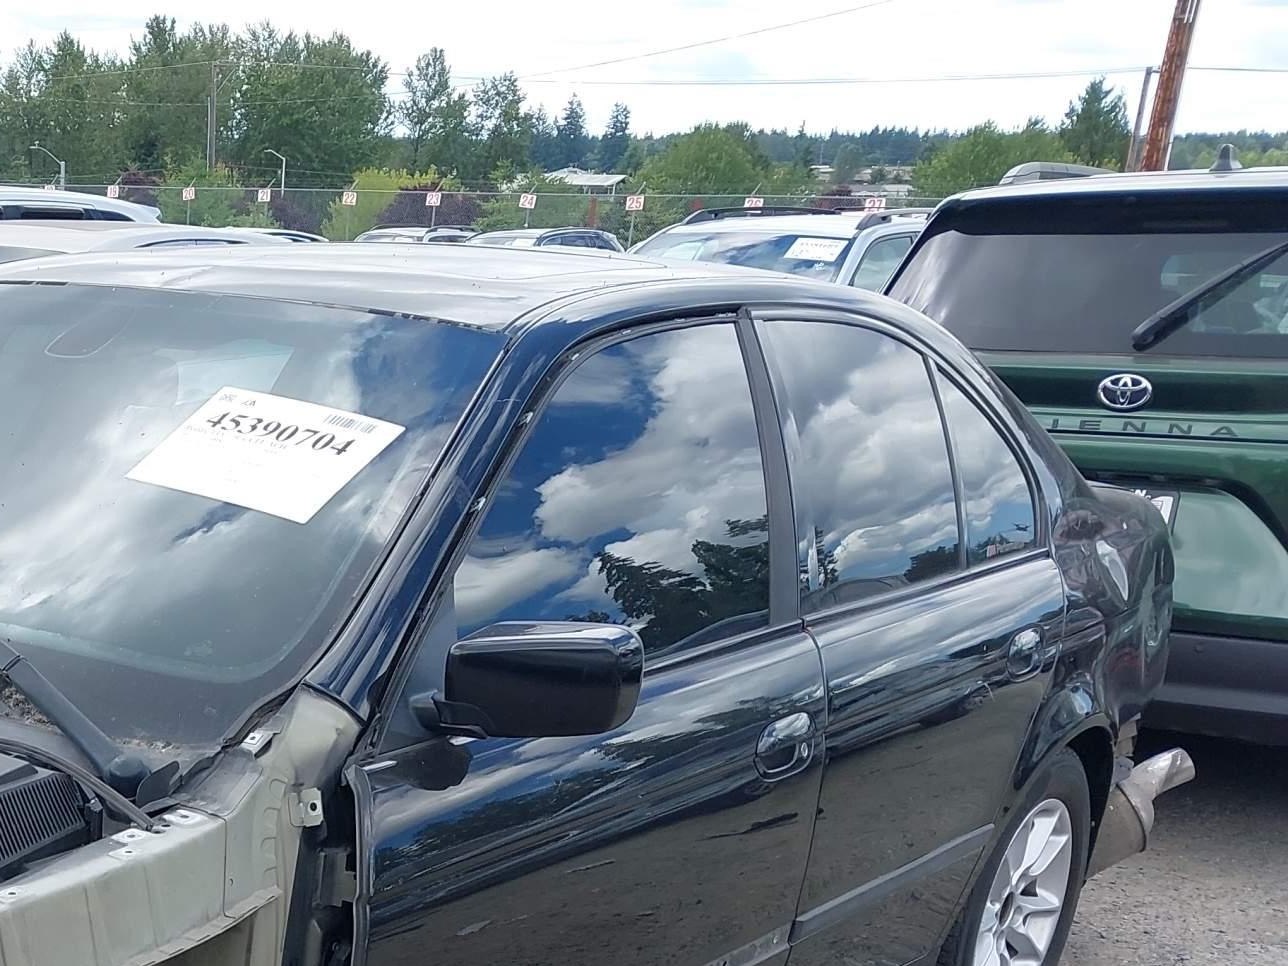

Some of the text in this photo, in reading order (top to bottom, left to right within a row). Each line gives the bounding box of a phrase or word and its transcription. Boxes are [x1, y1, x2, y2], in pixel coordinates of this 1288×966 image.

[108, 186, 118, 197] 19
[183, 188, 194, 199] 20
[259, 190, 269, 201] 21
[343, 192, 355, 204] 22
[427, 193, 440, 205] 23
[521, 195, 535, 207] 24
[627, 197, 642, 209] 25
[206, 410, 357, 456] 45390704
[1050, 418, 1239, 437] IENNA
